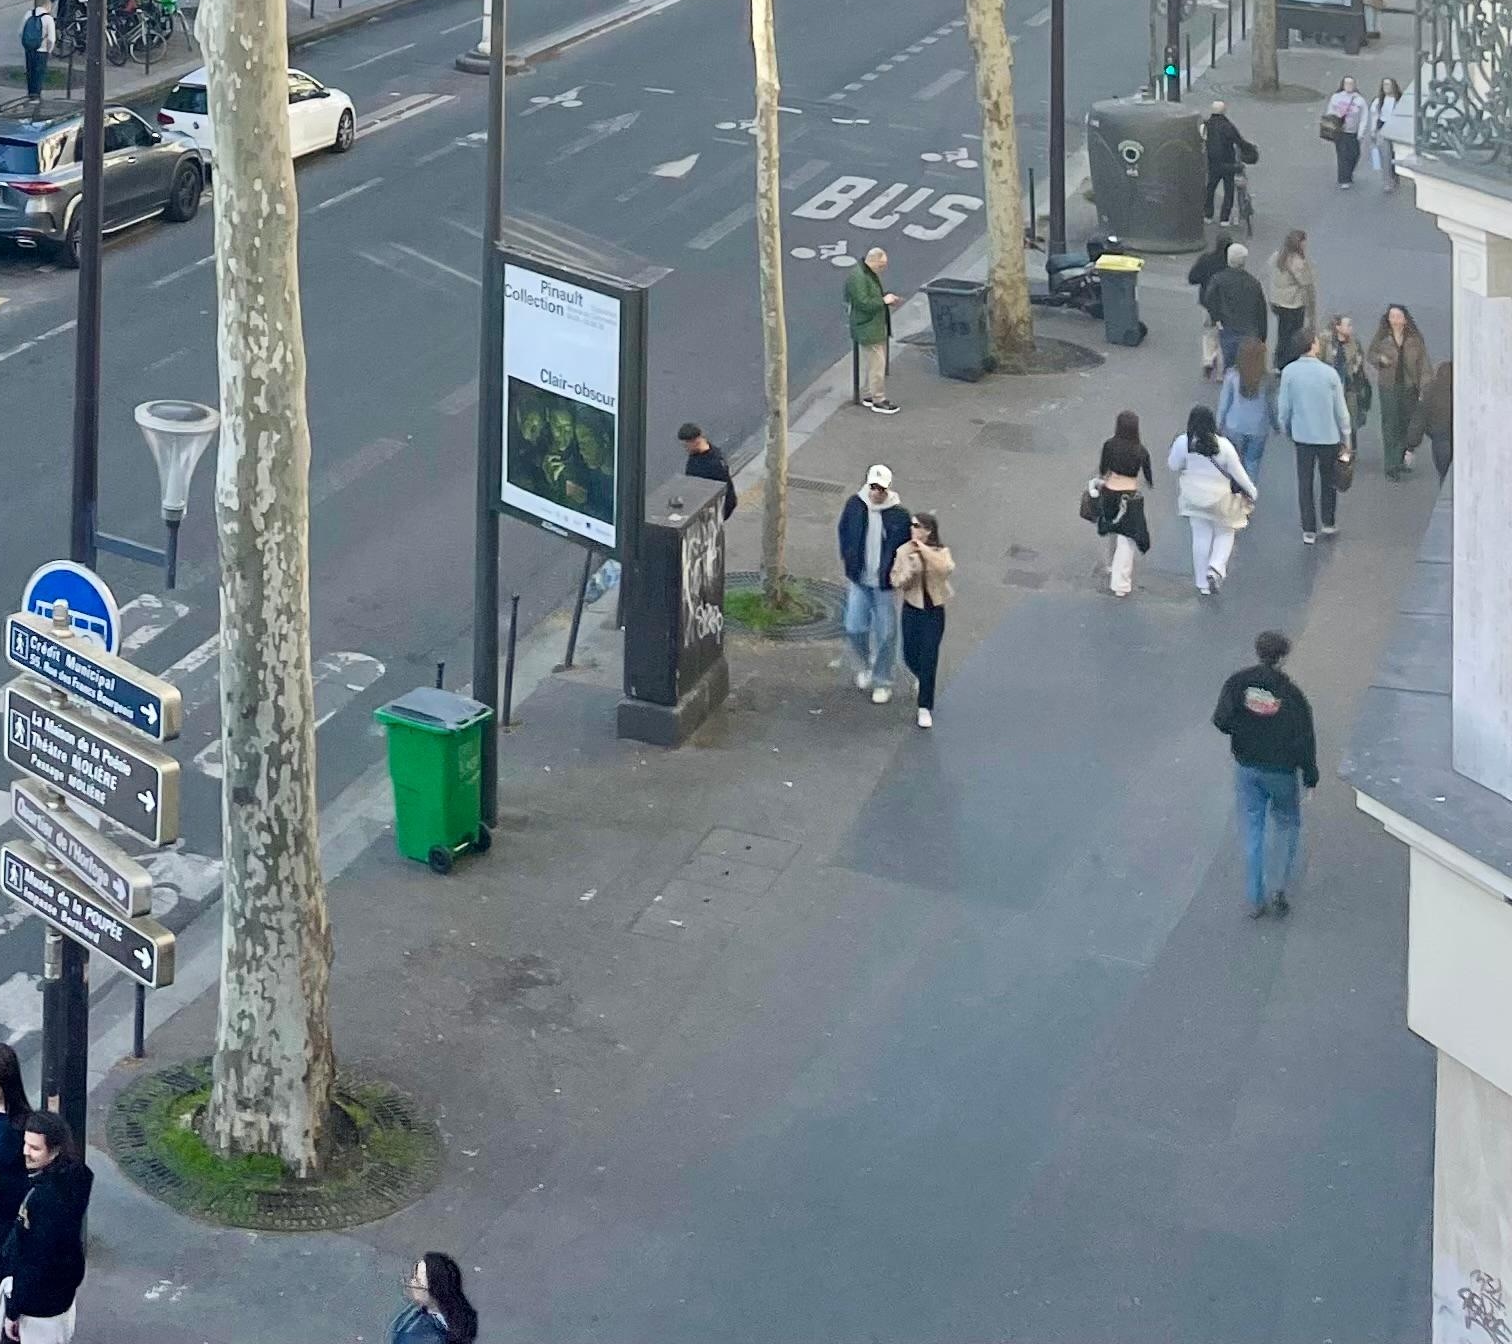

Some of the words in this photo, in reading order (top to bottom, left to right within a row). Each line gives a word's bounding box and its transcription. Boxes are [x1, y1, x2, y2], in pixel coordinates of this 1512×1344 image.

[791, 176, 984, 241] BUS
[504, 284, 564, 316] Collection
[540, 280, 584, 308] Pinault
[540, 368, 616, 408] Clair-obscur
[30, 636, 60, 662] Crédit
[65, 654, 116, 691] Municipal
[72, 676, 96, 698] Francs
[32, 710, 42, 728] La
[44, 718, 76, 746] Maison
[78, 736, 89, 752] de
[91, 742, 100, 759] la
[31, 731, 68, 763] Théâtre
[72, 754, 118, 790] MOLIÈRE
[31, 754, 65, 781] Passage
[17, 797, 53, 839] Quartier
[56, 832, 68, 851] de
[23, 886, 57, 916] Impasse
[24, 867, 54, 898] Musée
[57, 891, 70, 907] de
[72, 898, 82, 916] la
[85, 906, 122, 942] POUPÉE
